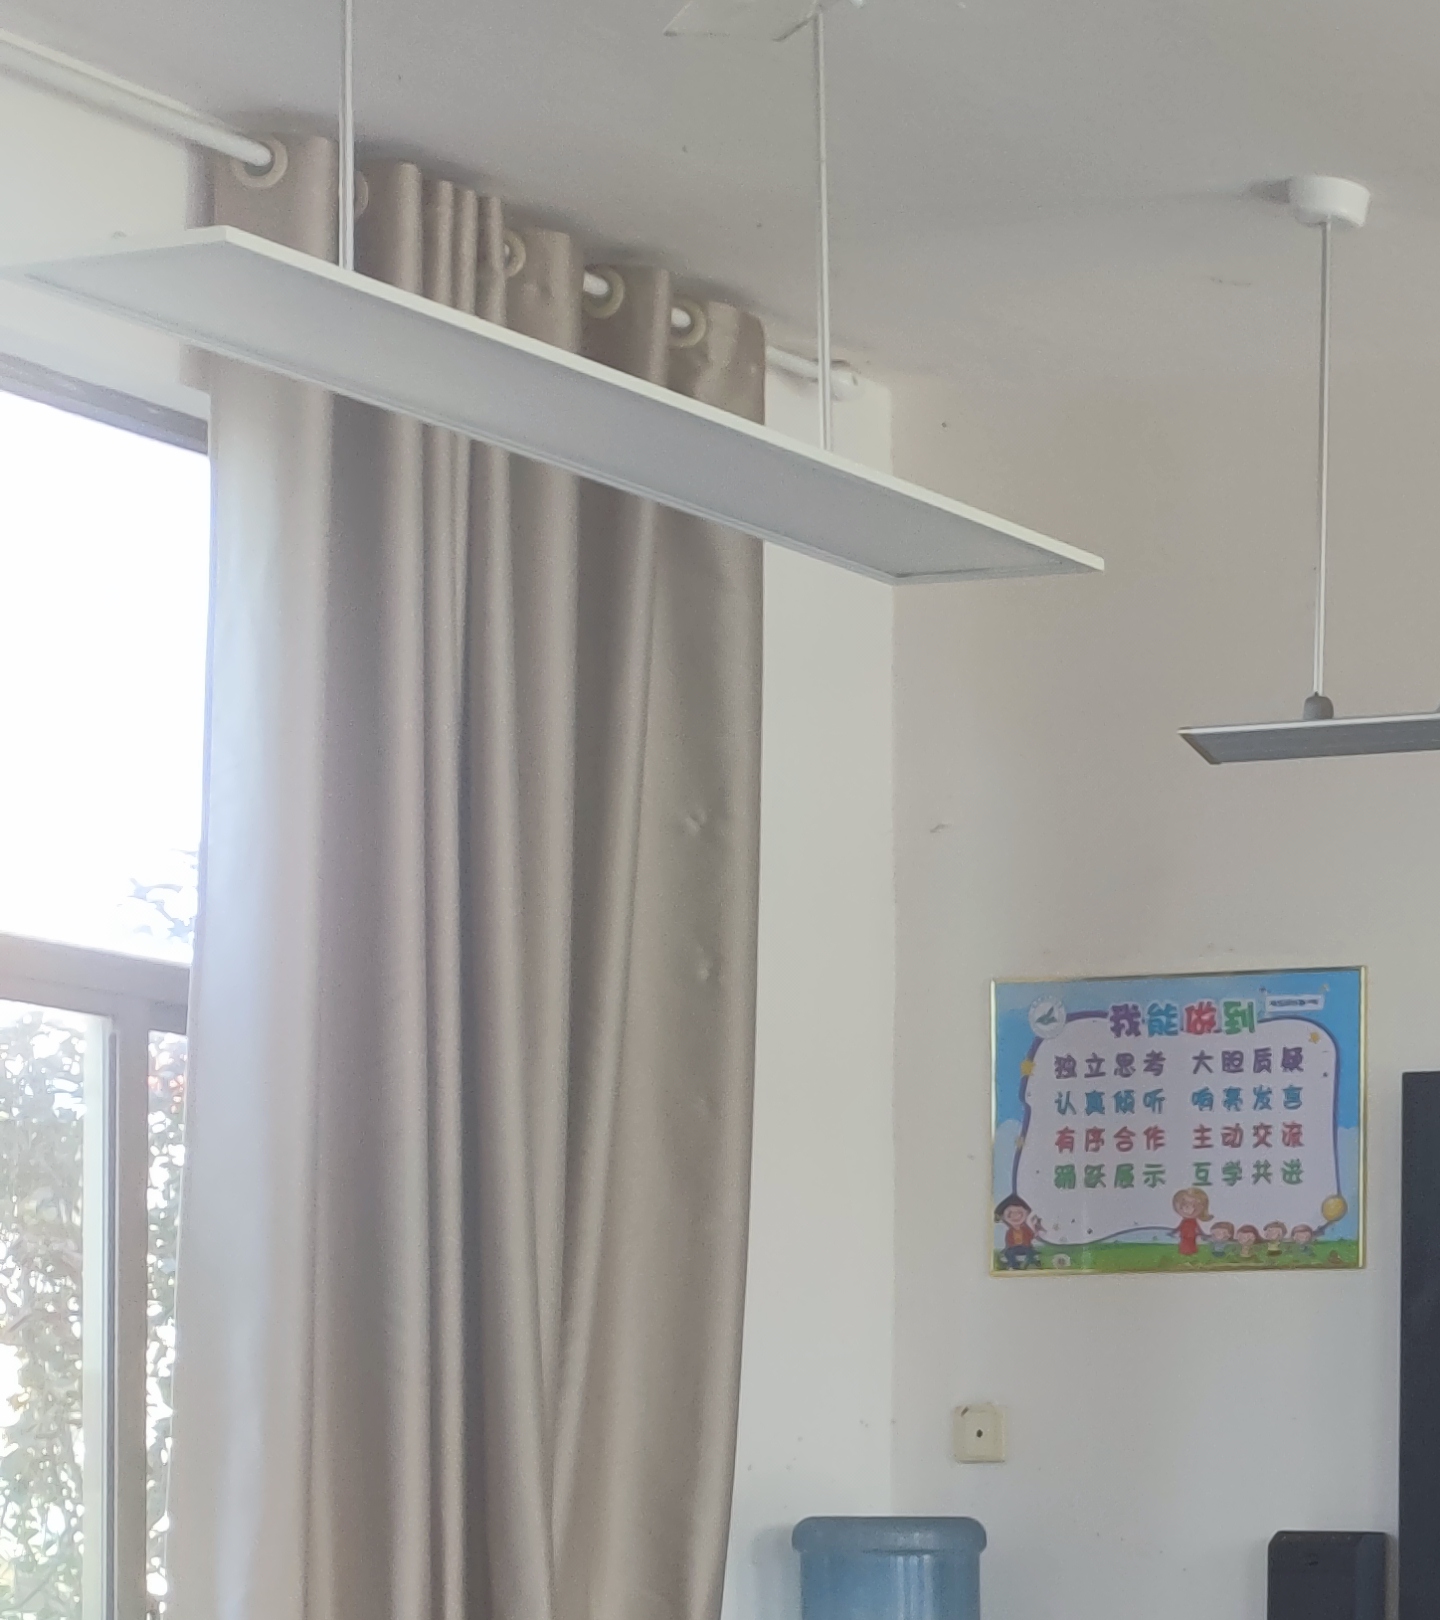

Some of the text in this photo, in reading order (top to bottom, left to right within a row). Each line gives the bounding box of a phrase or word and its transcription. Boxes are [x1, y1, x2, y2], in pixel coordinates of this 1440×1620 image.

[1108, 999, 1256, 1038] 我能做到
[1054, 1050, 1167, 1080] 独立思考
[1054, 1083, 1305, 1116] 认真倾听 响亮发言
[1054, 1120, 1305, 1154] 有序合作 主动交流
[1191, 1157, 1305, 1188] 互学共进
